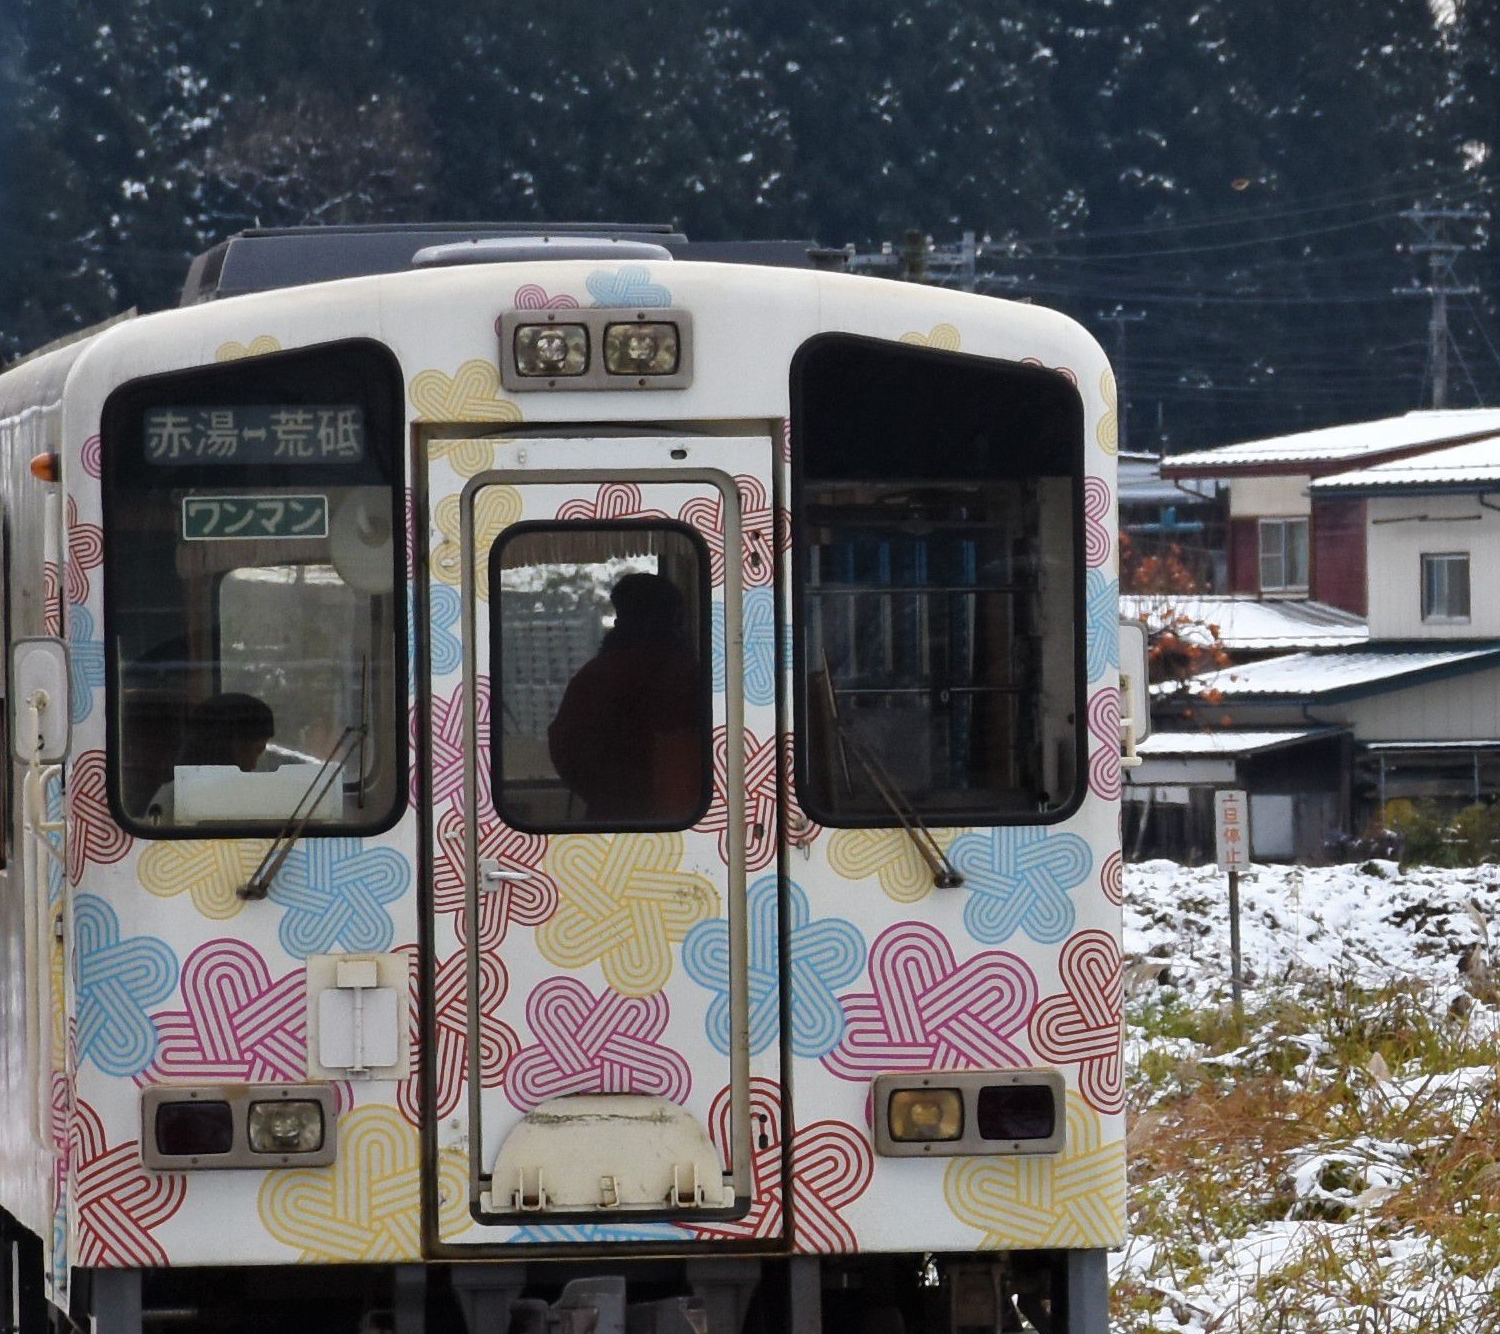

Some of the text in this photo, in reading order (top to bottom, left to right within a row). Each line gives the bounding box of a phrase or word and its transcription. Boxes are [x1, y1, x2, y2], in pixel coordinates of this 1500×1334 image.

[147, 409, 362, 459] 赤湯 荒砥
[188, 501, 323, 535] ワンマン
[1222, 798, 1242, 864] 一旦停止
